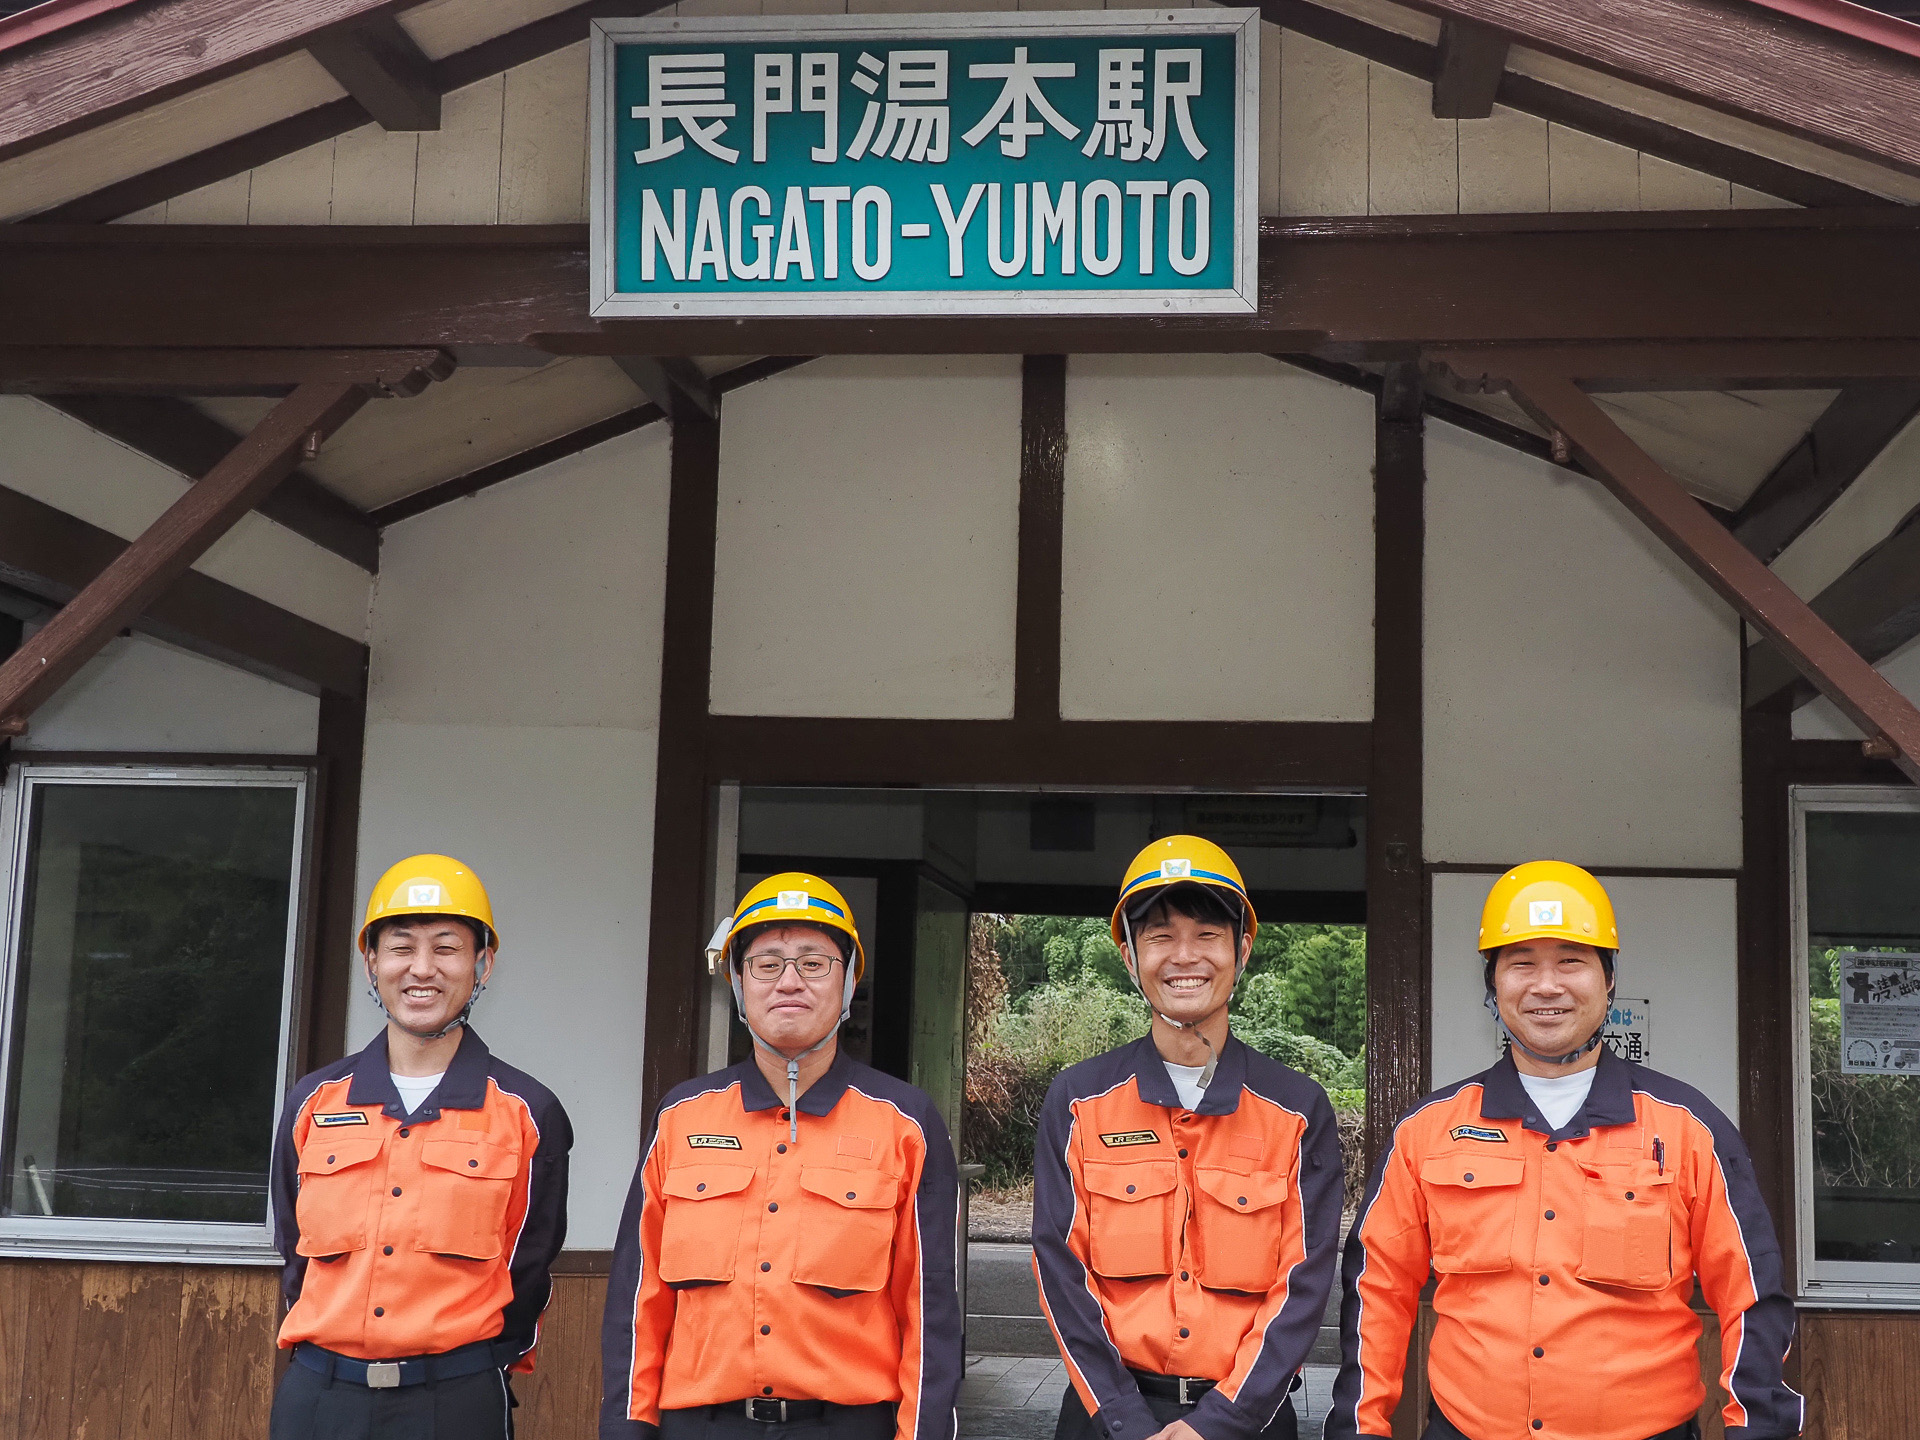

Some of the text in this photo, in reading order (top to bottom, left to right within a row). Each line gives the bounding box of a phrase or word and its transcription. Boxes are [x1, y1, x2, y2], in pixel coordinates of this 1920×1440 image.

[631, 46, 1208, 165] 長門湯本駅
[641, 178, 1211, 282] NAGATO-YUMOTO
